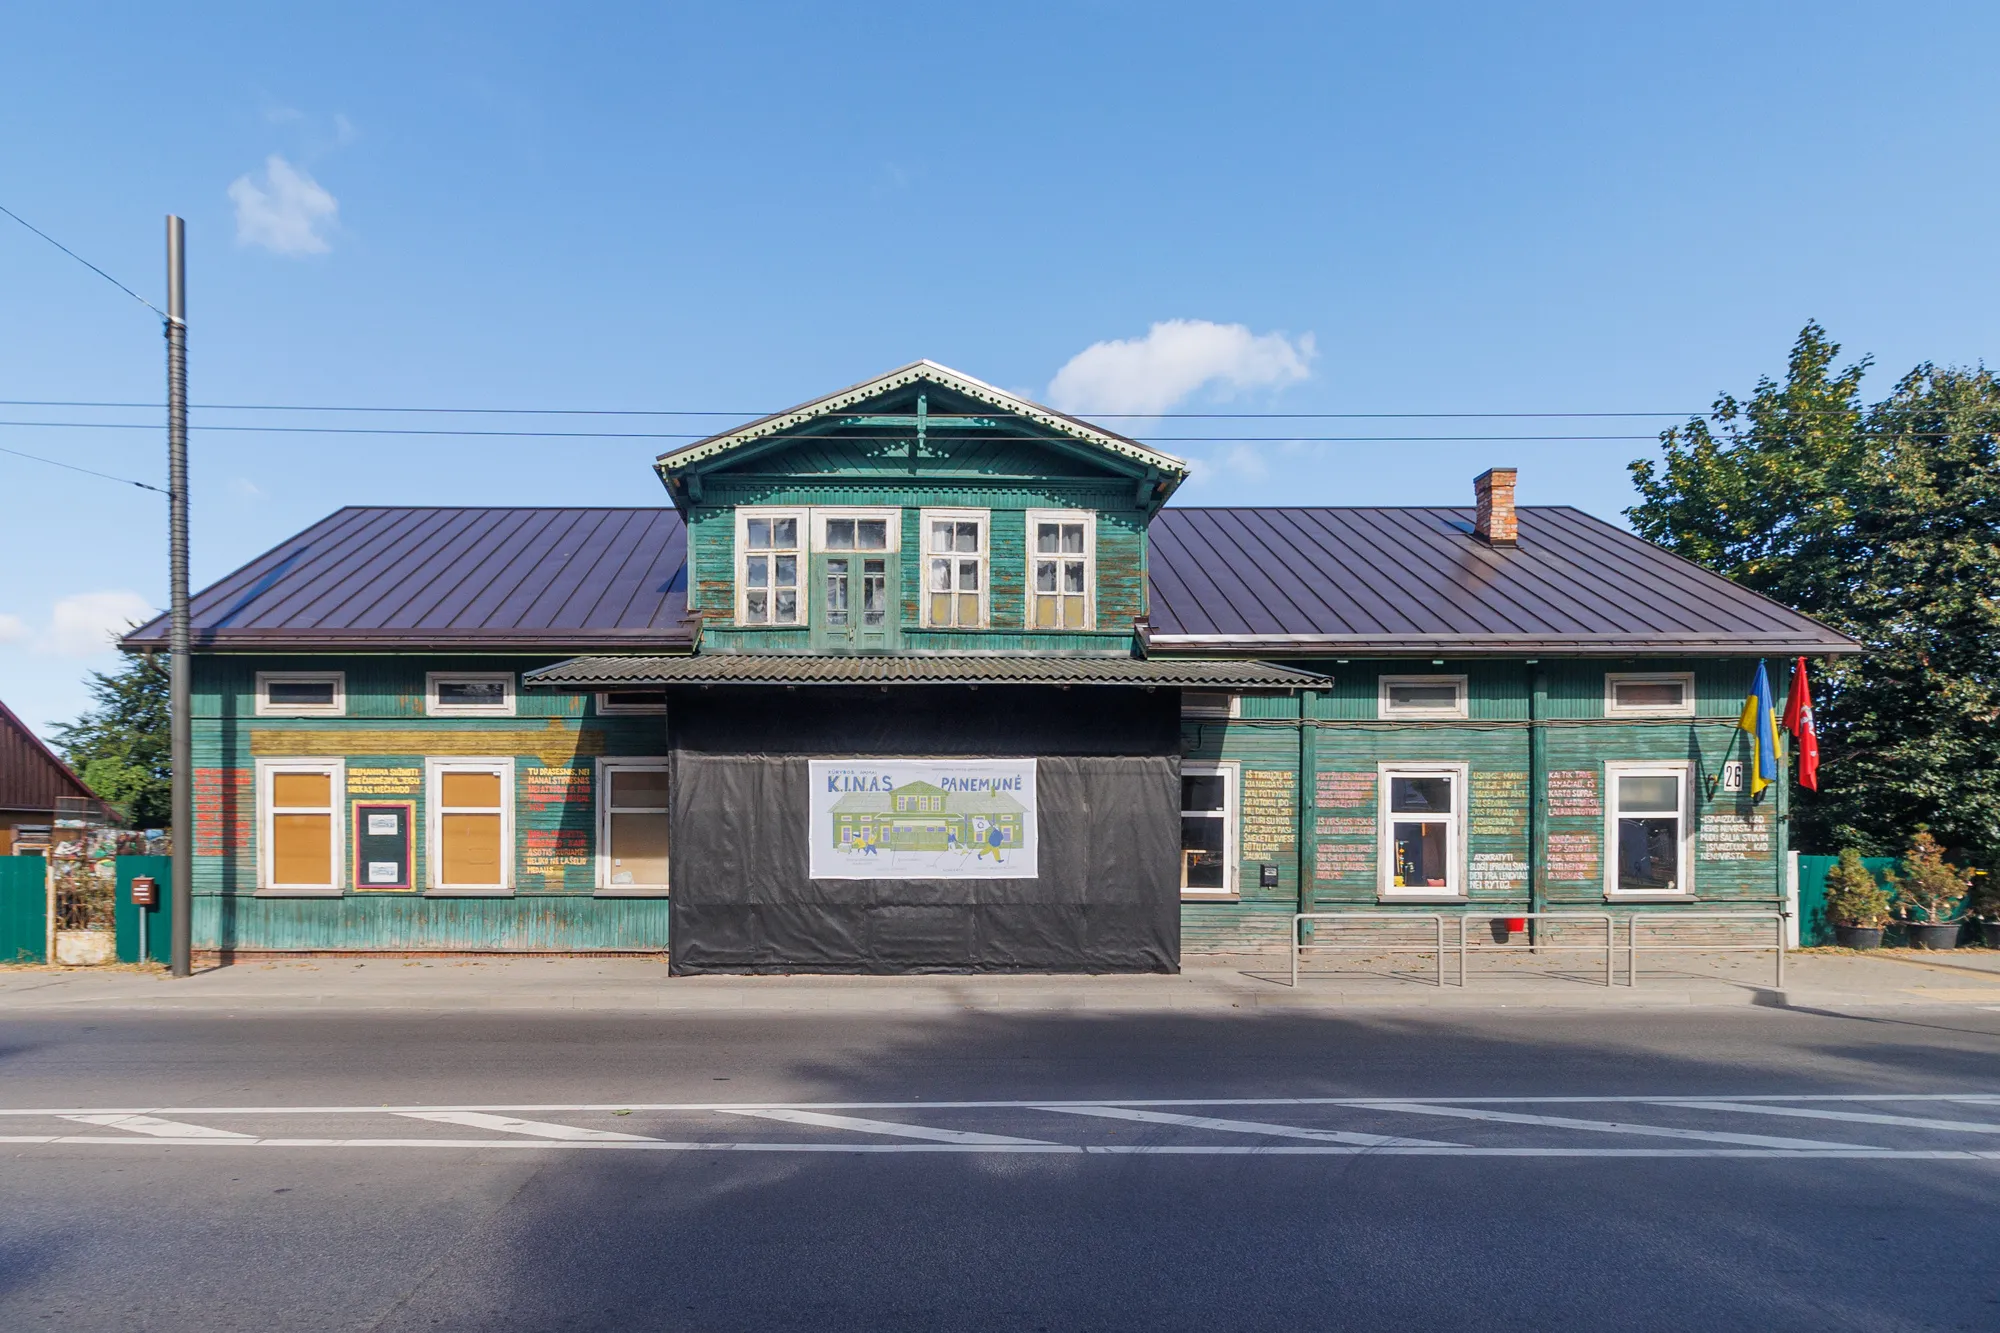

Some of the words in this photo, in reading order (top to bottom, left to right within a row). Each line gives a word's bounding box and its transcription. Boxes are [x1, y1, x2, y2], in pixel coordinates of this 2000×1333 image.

[527, 768, 539, 776] TU
[578, 768, 590, 776] NEI
[1548, 771, 1561, 779] KAI
[1725, 766, 1742, 787] 26
[941, 774, 1022, 792] PANEMUNĖ
[1548, 789, 1571, 798] KARTO
[1571, 789, 1598, 798] SUPRA-
[1470, 808, 1485, 816] JOS
[1244, 816, 1265, 824] NETURI
[1266, 816, 1275, 824] SU
[1276, 816, 1290, 824] KUO
[1749, 815, 1765, 824] KAD
[1244, 825, 1258, 833] APIE
[1719, 832, 1740, 841] ŠALIA
[1753, 842, 1768, 851] KAD
[1484, 871, 1498, 880] YRA
[1499, 871, 1528, 880] LENGVIAU
[1470, 880, 1482, 889] NEI
